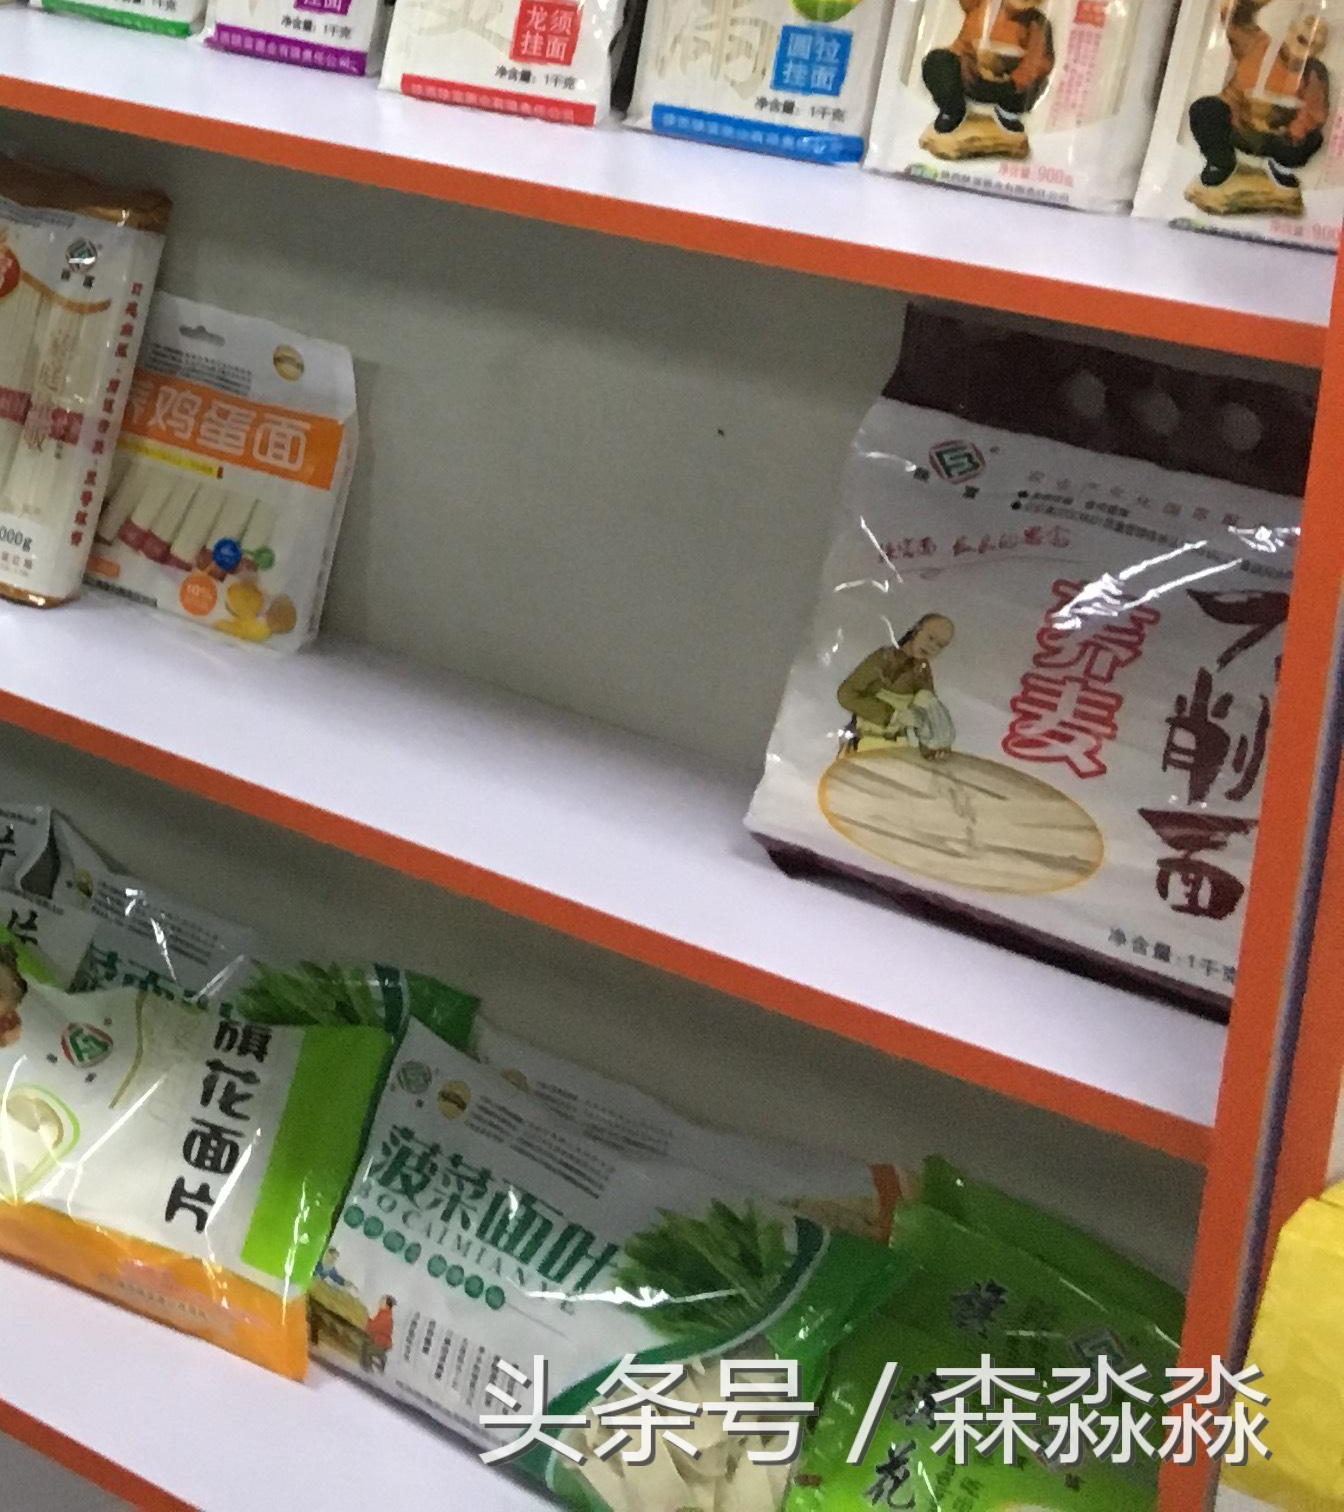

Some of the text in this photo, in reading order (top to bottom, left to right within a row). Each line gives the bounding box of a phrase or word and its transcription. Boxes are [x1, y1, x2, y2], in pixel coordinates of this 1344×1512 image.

[526, 5, 576, 36] 龙须
[520, 30, 570, 61] 挂面
[371, 1125, 621, 1291] 菠菜面叶
